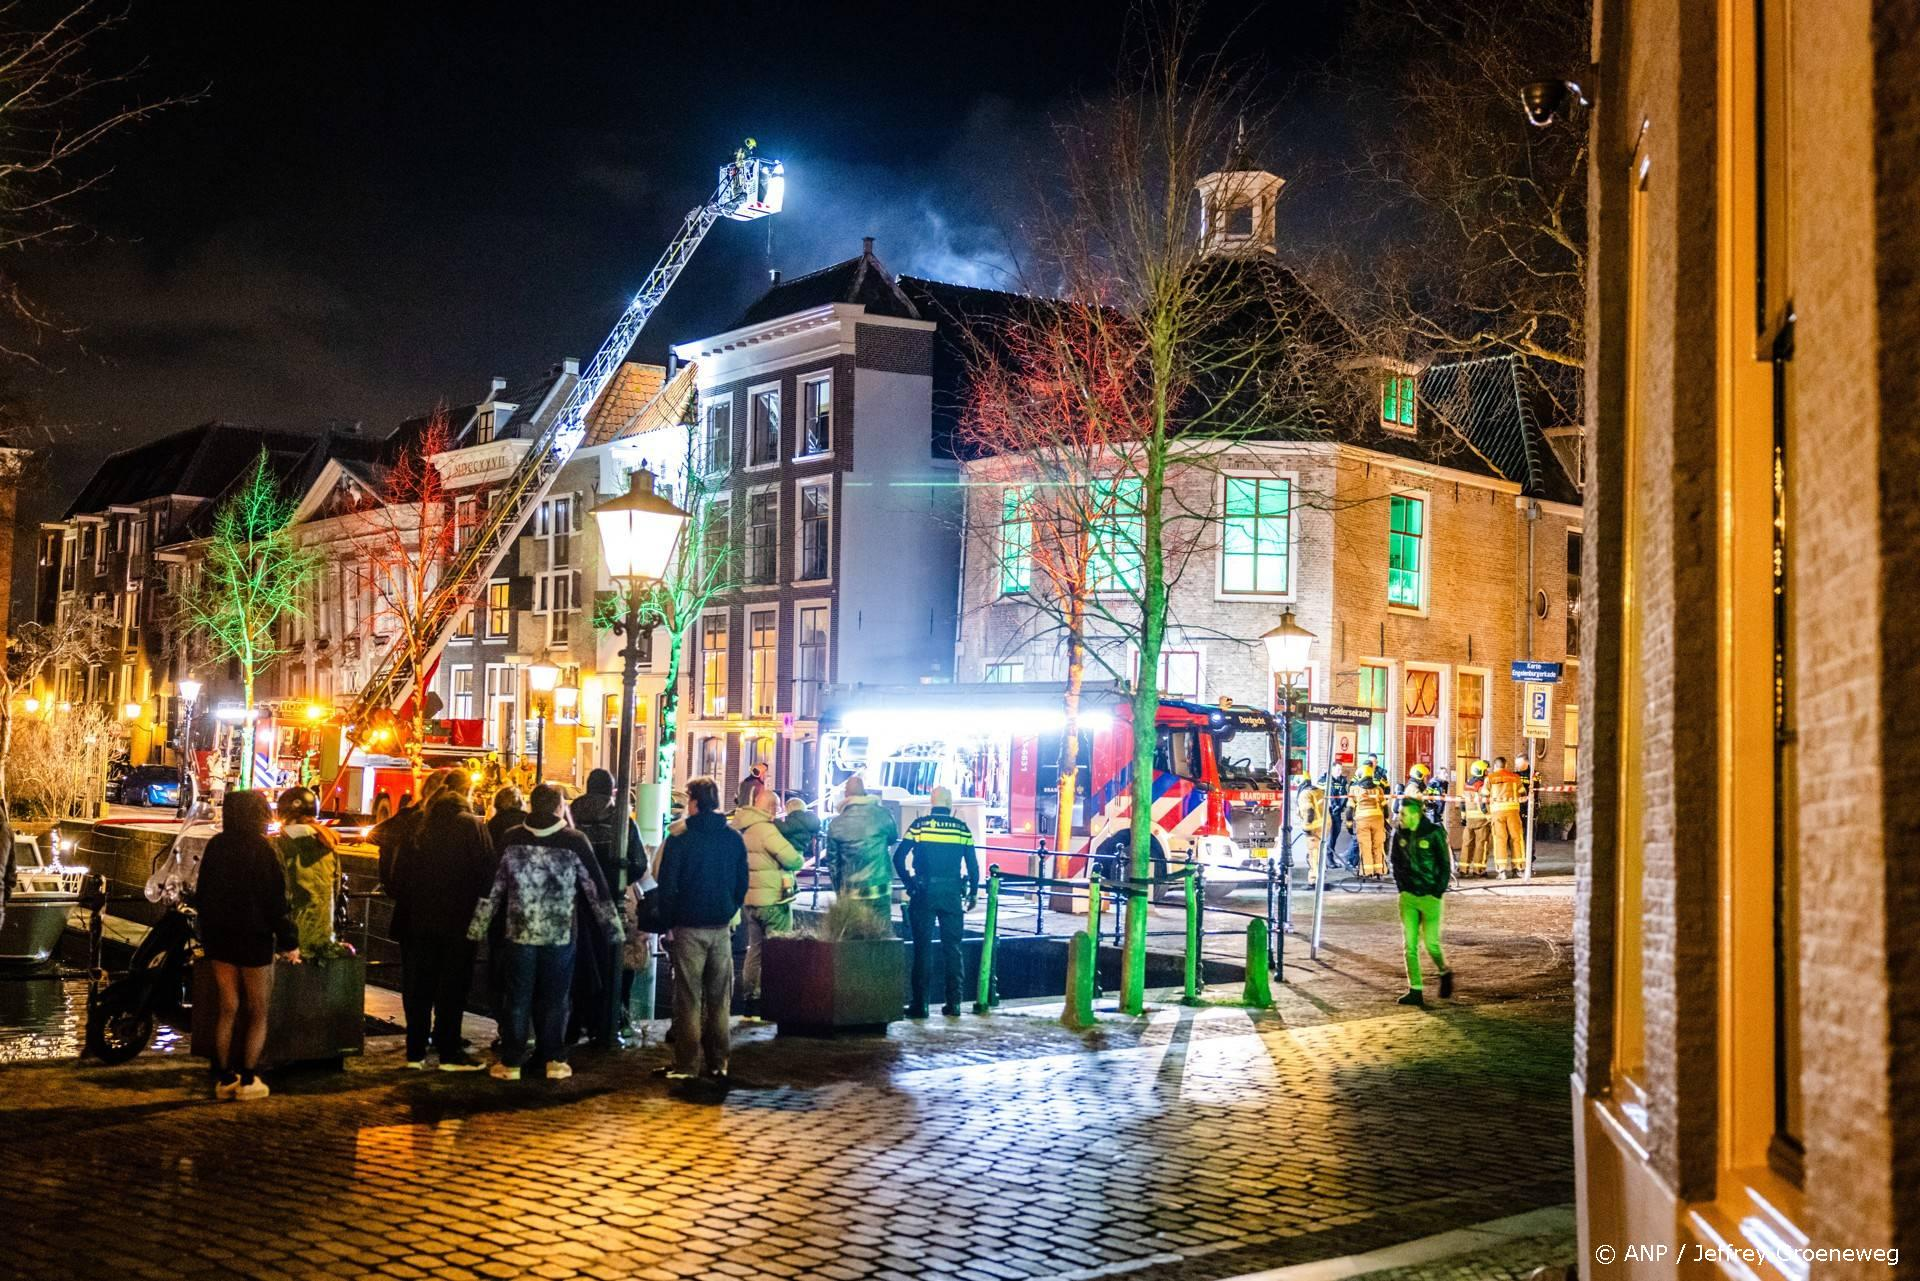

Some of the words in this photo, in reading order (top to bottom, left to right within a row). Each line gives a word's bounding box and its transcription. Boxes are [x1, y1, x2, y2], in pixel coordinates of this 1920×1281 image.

[1309, 704, 1328, 715] Lange
[1329, 706, 1370, 718] Geldersekade
[1240, 791, 1275, 800] BRANDWEER
